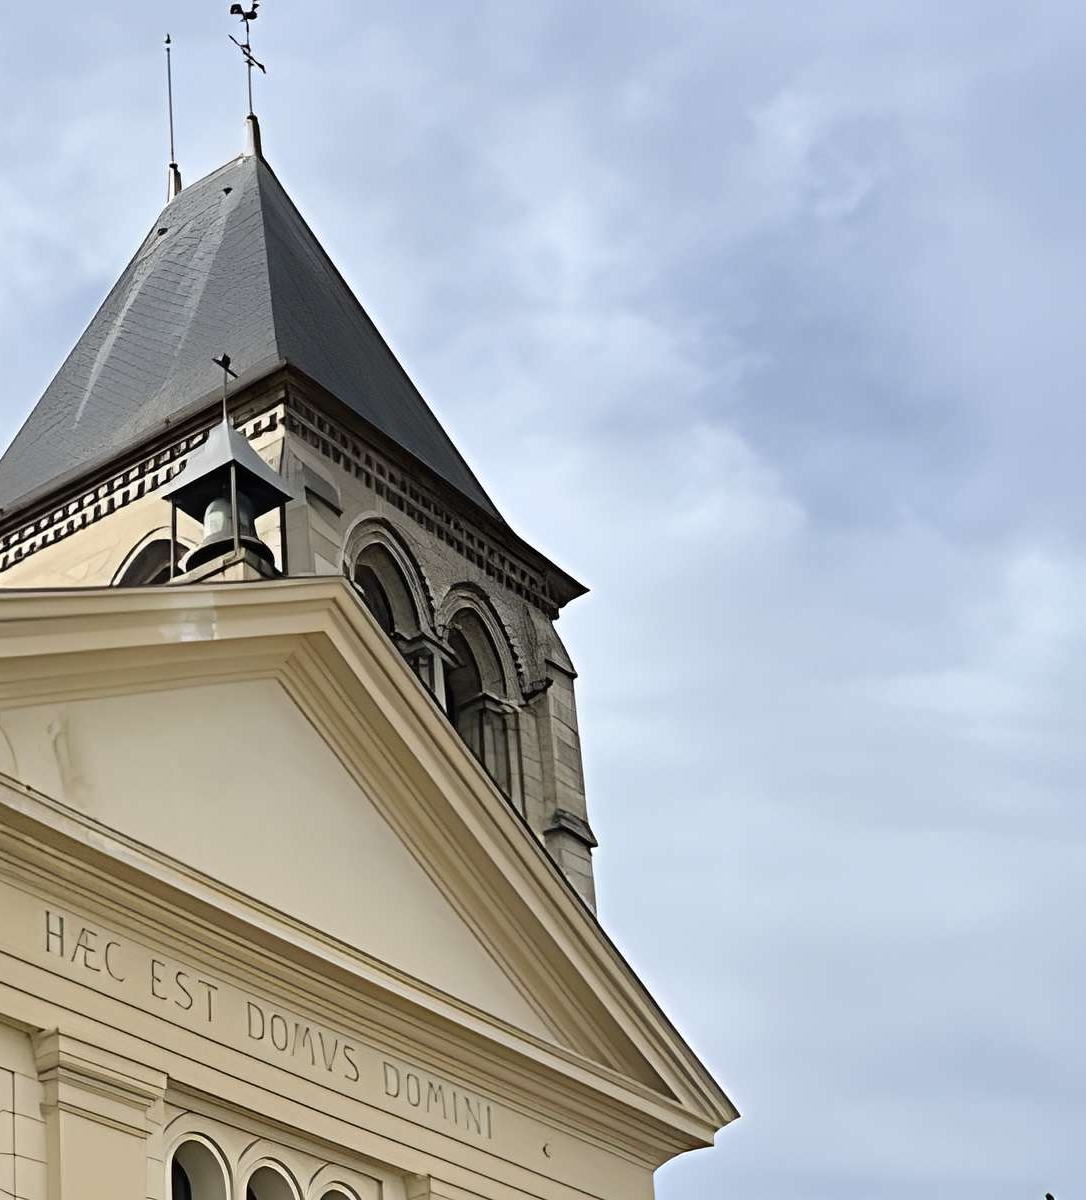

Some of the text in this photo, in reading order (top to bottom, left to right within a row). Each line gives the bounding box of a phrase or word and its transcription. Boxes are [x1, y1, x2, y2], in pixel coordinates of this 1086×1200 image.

[45, 909, 493, 1139] HÆC EST DOMVS DOMINI
